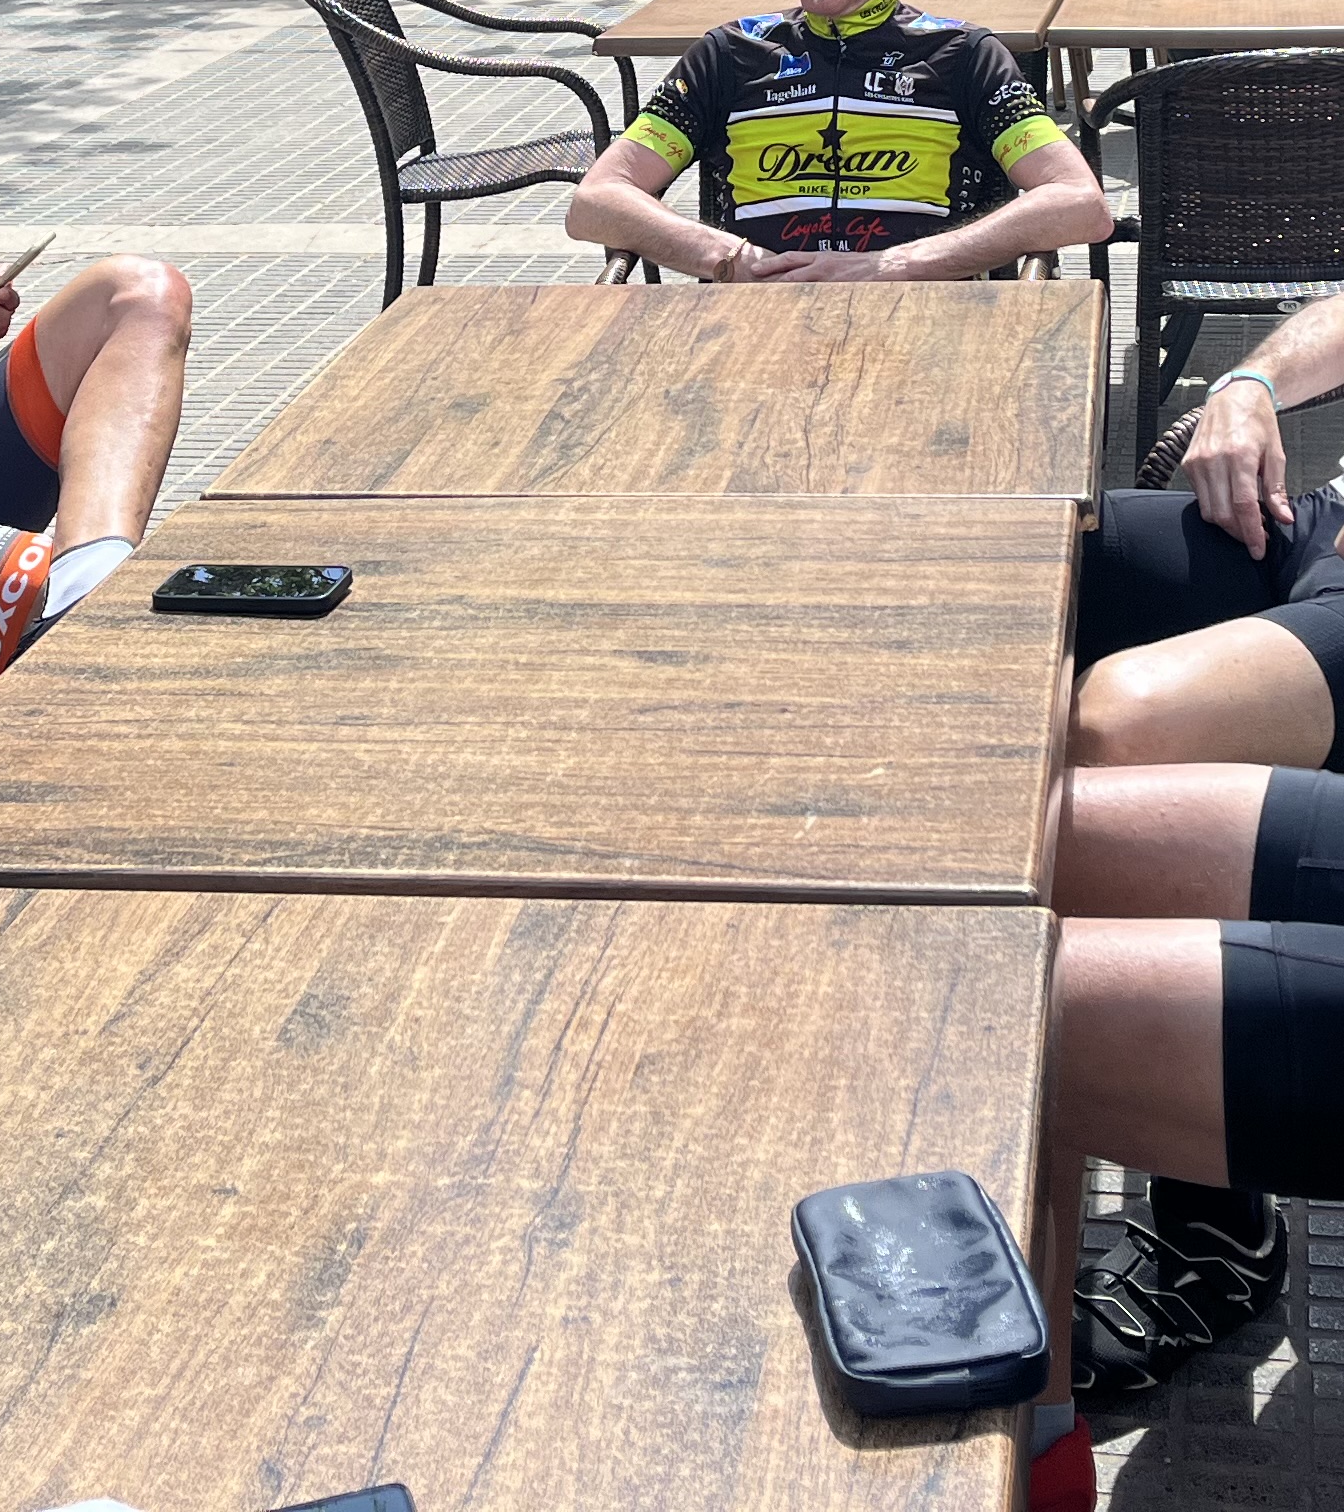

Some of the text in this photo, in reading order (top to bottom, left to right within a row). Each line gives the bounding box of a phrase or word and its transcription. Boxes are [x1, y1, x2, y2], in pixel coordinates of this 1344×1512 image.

[766, 84, 817, 103] Tageblatt
[757, 143, 919, 182] Dream
[799, 185, 870, 195] BIKE HOP
[781, 213, 890, 252] Coyote Cafe
